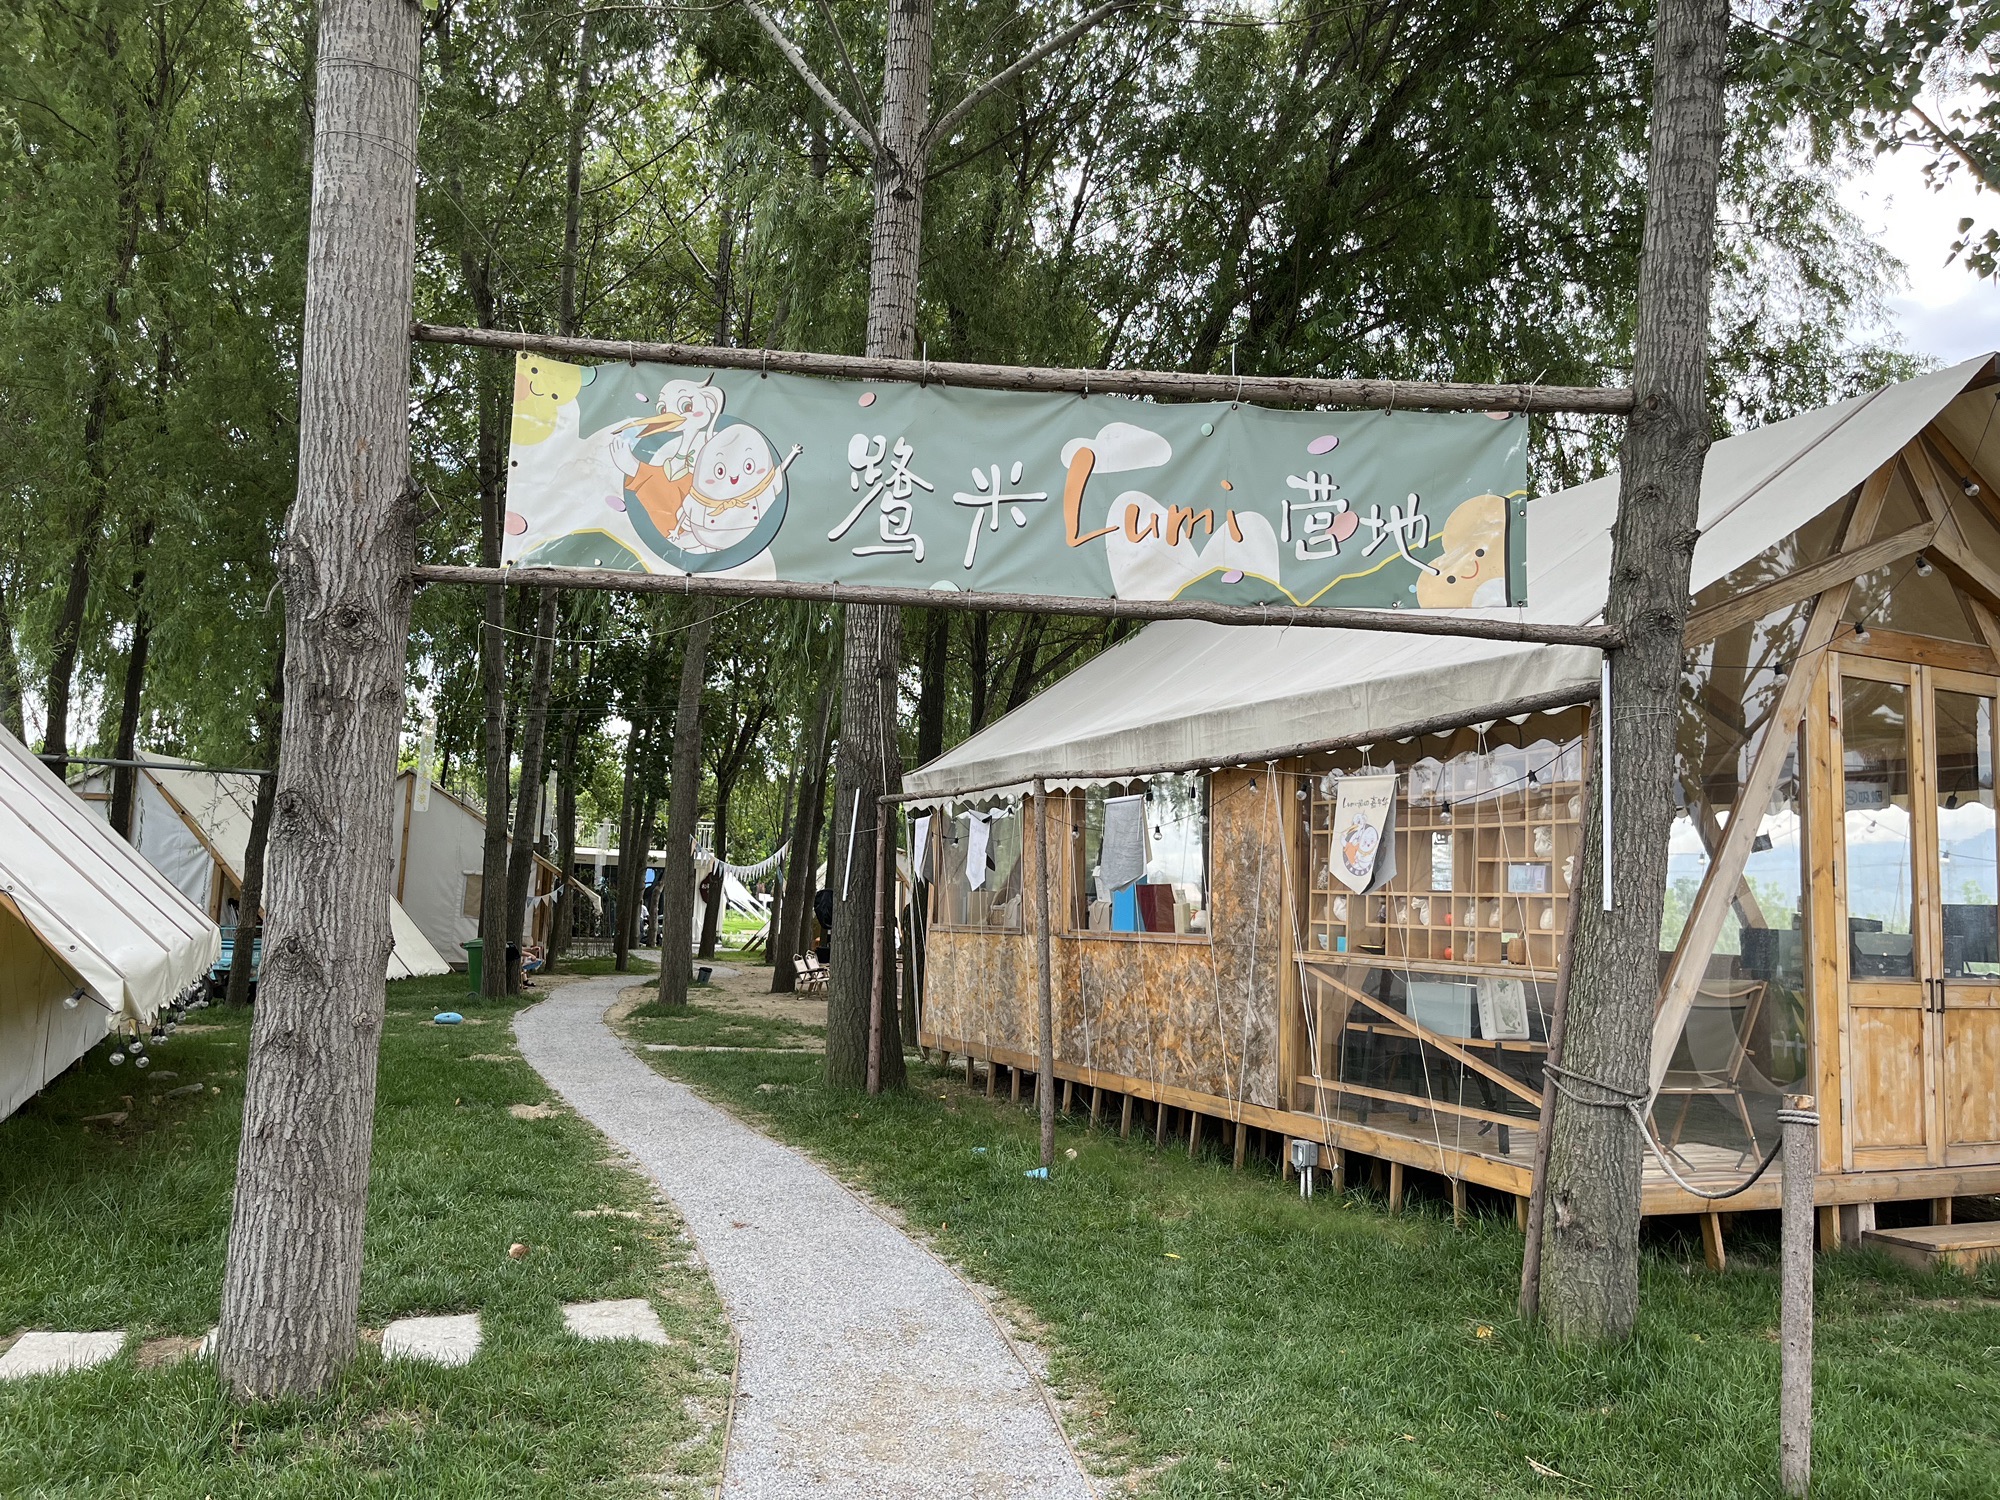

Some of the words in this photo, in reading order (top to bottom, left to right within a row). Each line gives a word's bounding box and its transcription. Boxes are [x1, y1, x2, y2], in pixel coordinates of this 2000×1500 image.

[828, 433, 1049, 568] 鹭米
[1063, 446, 1244, 548] Lumi
[1281, 470, 1440, 576] 营地
